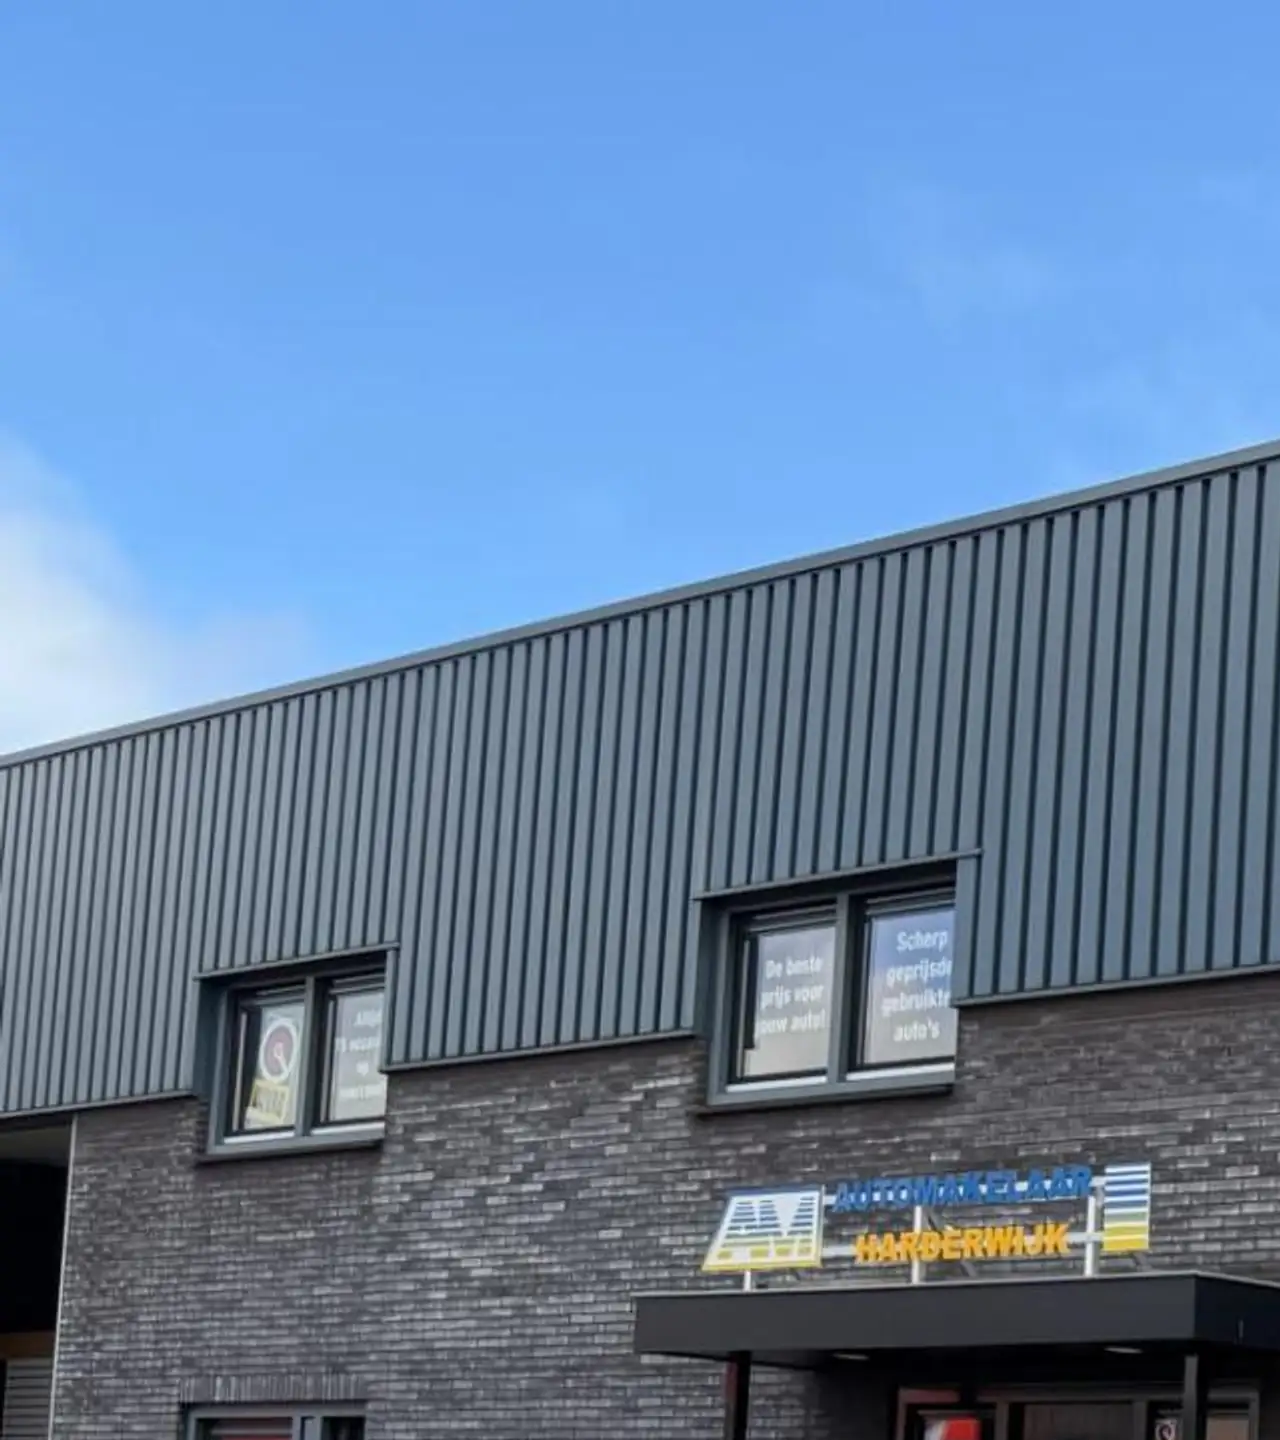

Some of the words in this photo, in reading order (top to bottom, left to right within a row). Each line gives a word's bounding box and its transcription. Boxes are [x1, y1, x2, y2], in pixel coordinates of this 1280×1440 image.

[896, 930, 948, 953] Scherp
[894, 1017, 940, 1042] auto's
[832, 1164, 1092, 1213] AUTOMAKELAAR
[855, 1222, 1071, 1264] HARDERWIJK
